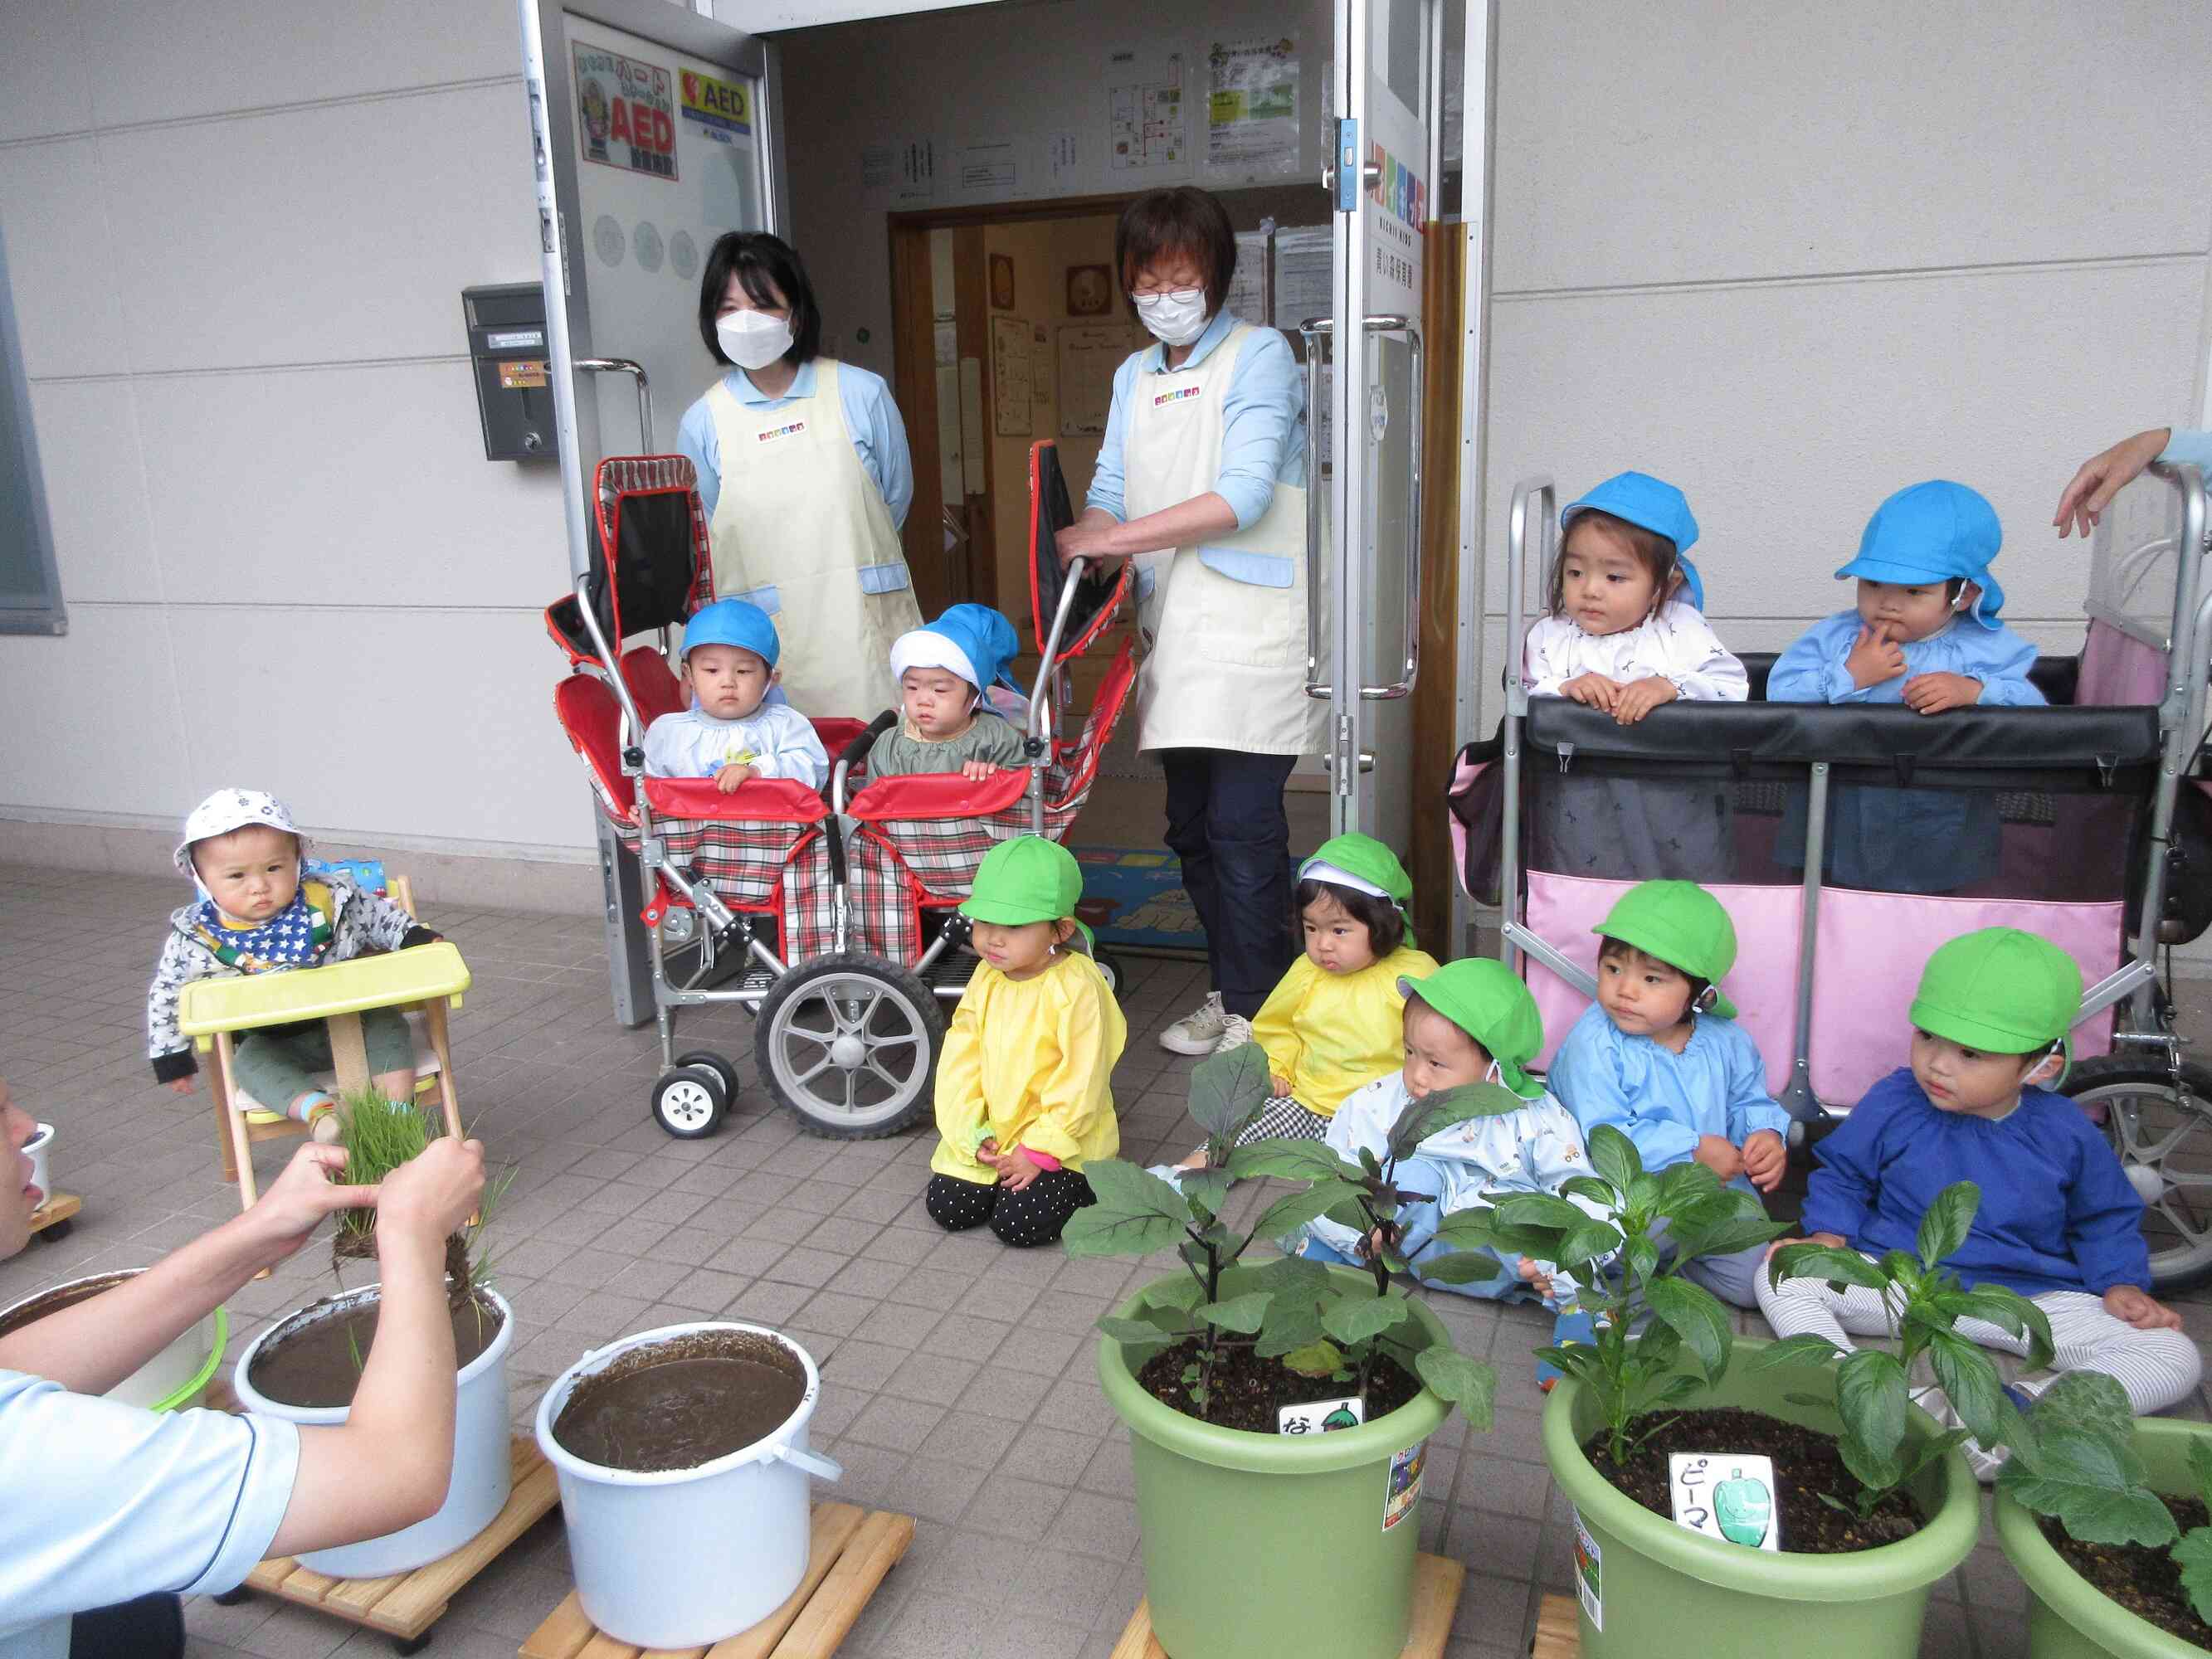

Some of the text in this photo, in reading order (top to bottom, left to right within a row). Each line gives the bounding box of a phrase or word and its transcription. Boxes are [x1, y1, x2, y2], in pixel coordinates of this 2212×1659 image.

[704, 84, 744, 115] AED
[611, 95, 673, 153] AED
[1283, 1416, 1311, 1434] な
